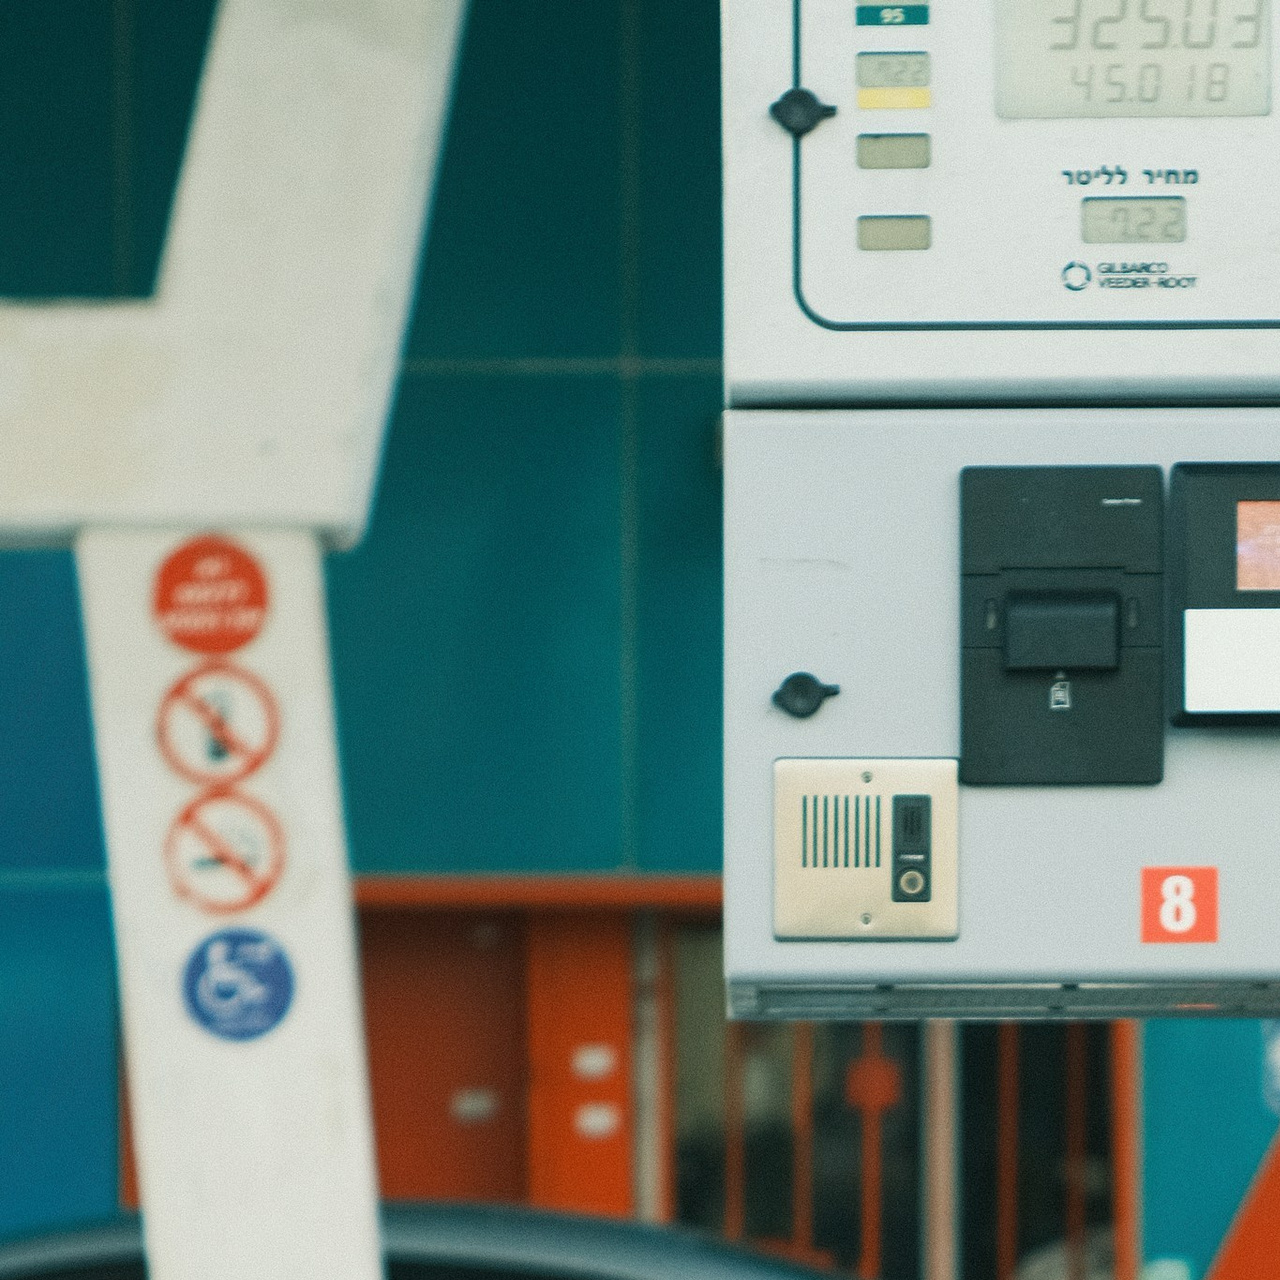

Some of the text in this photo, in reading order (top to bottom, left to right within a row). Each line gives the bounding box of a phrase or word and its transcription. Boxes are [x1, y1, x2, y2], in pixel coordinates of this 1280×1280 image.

[1061, 164, 1199, 185] מחיר לליטר
[1160, 876, 1197, 932] 8
